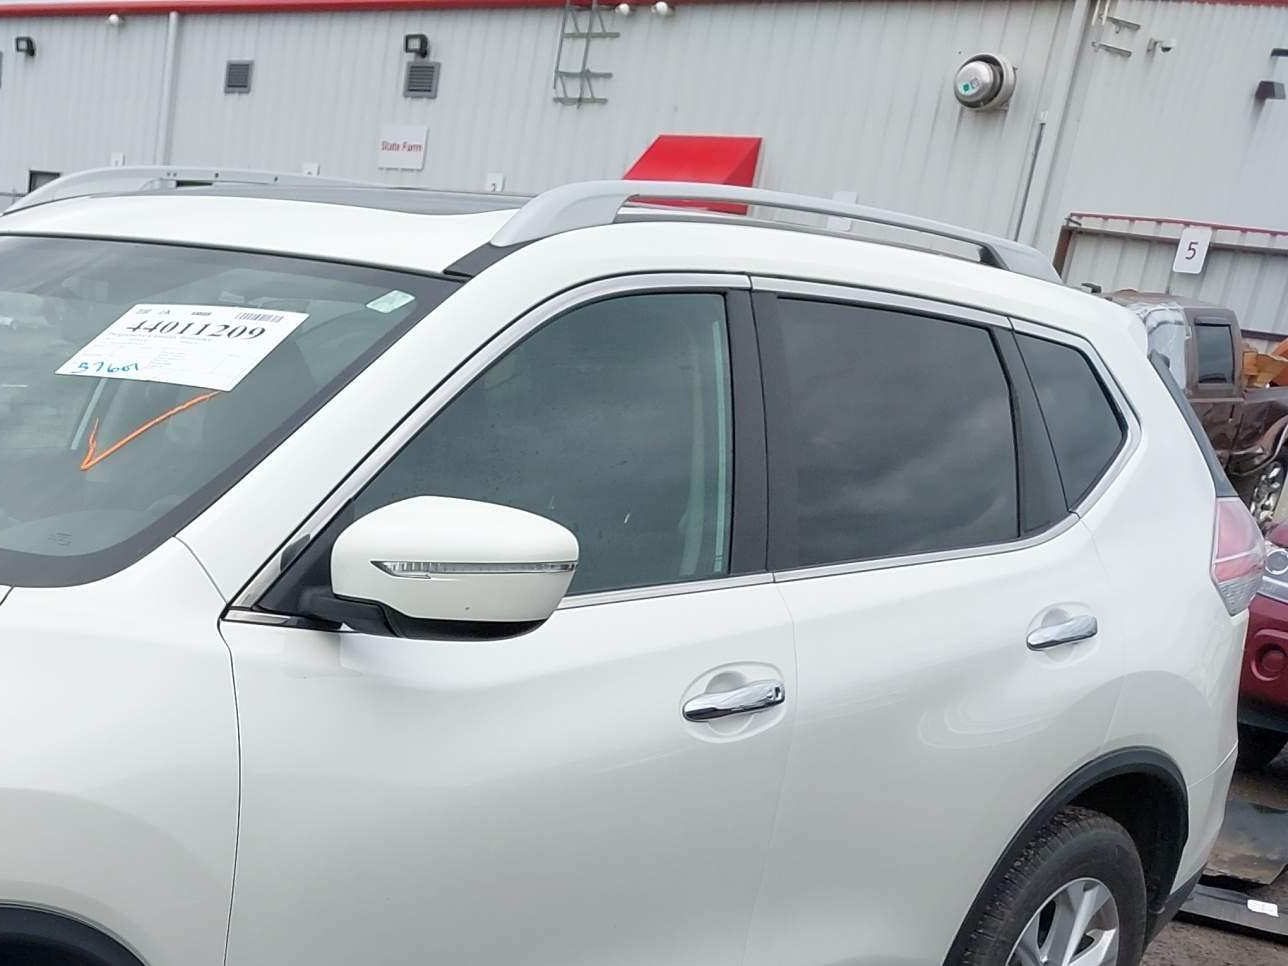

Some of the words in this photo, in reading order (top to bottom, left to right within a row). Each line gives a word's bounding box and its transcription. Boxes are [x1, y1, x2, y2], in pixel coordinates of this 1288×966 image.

[380, 140, 400, 152] State
[401, 141, 422, 153] Farm
[1184, 241, 1199, 261] 5
[126, 319, 266, 340] 44011209
